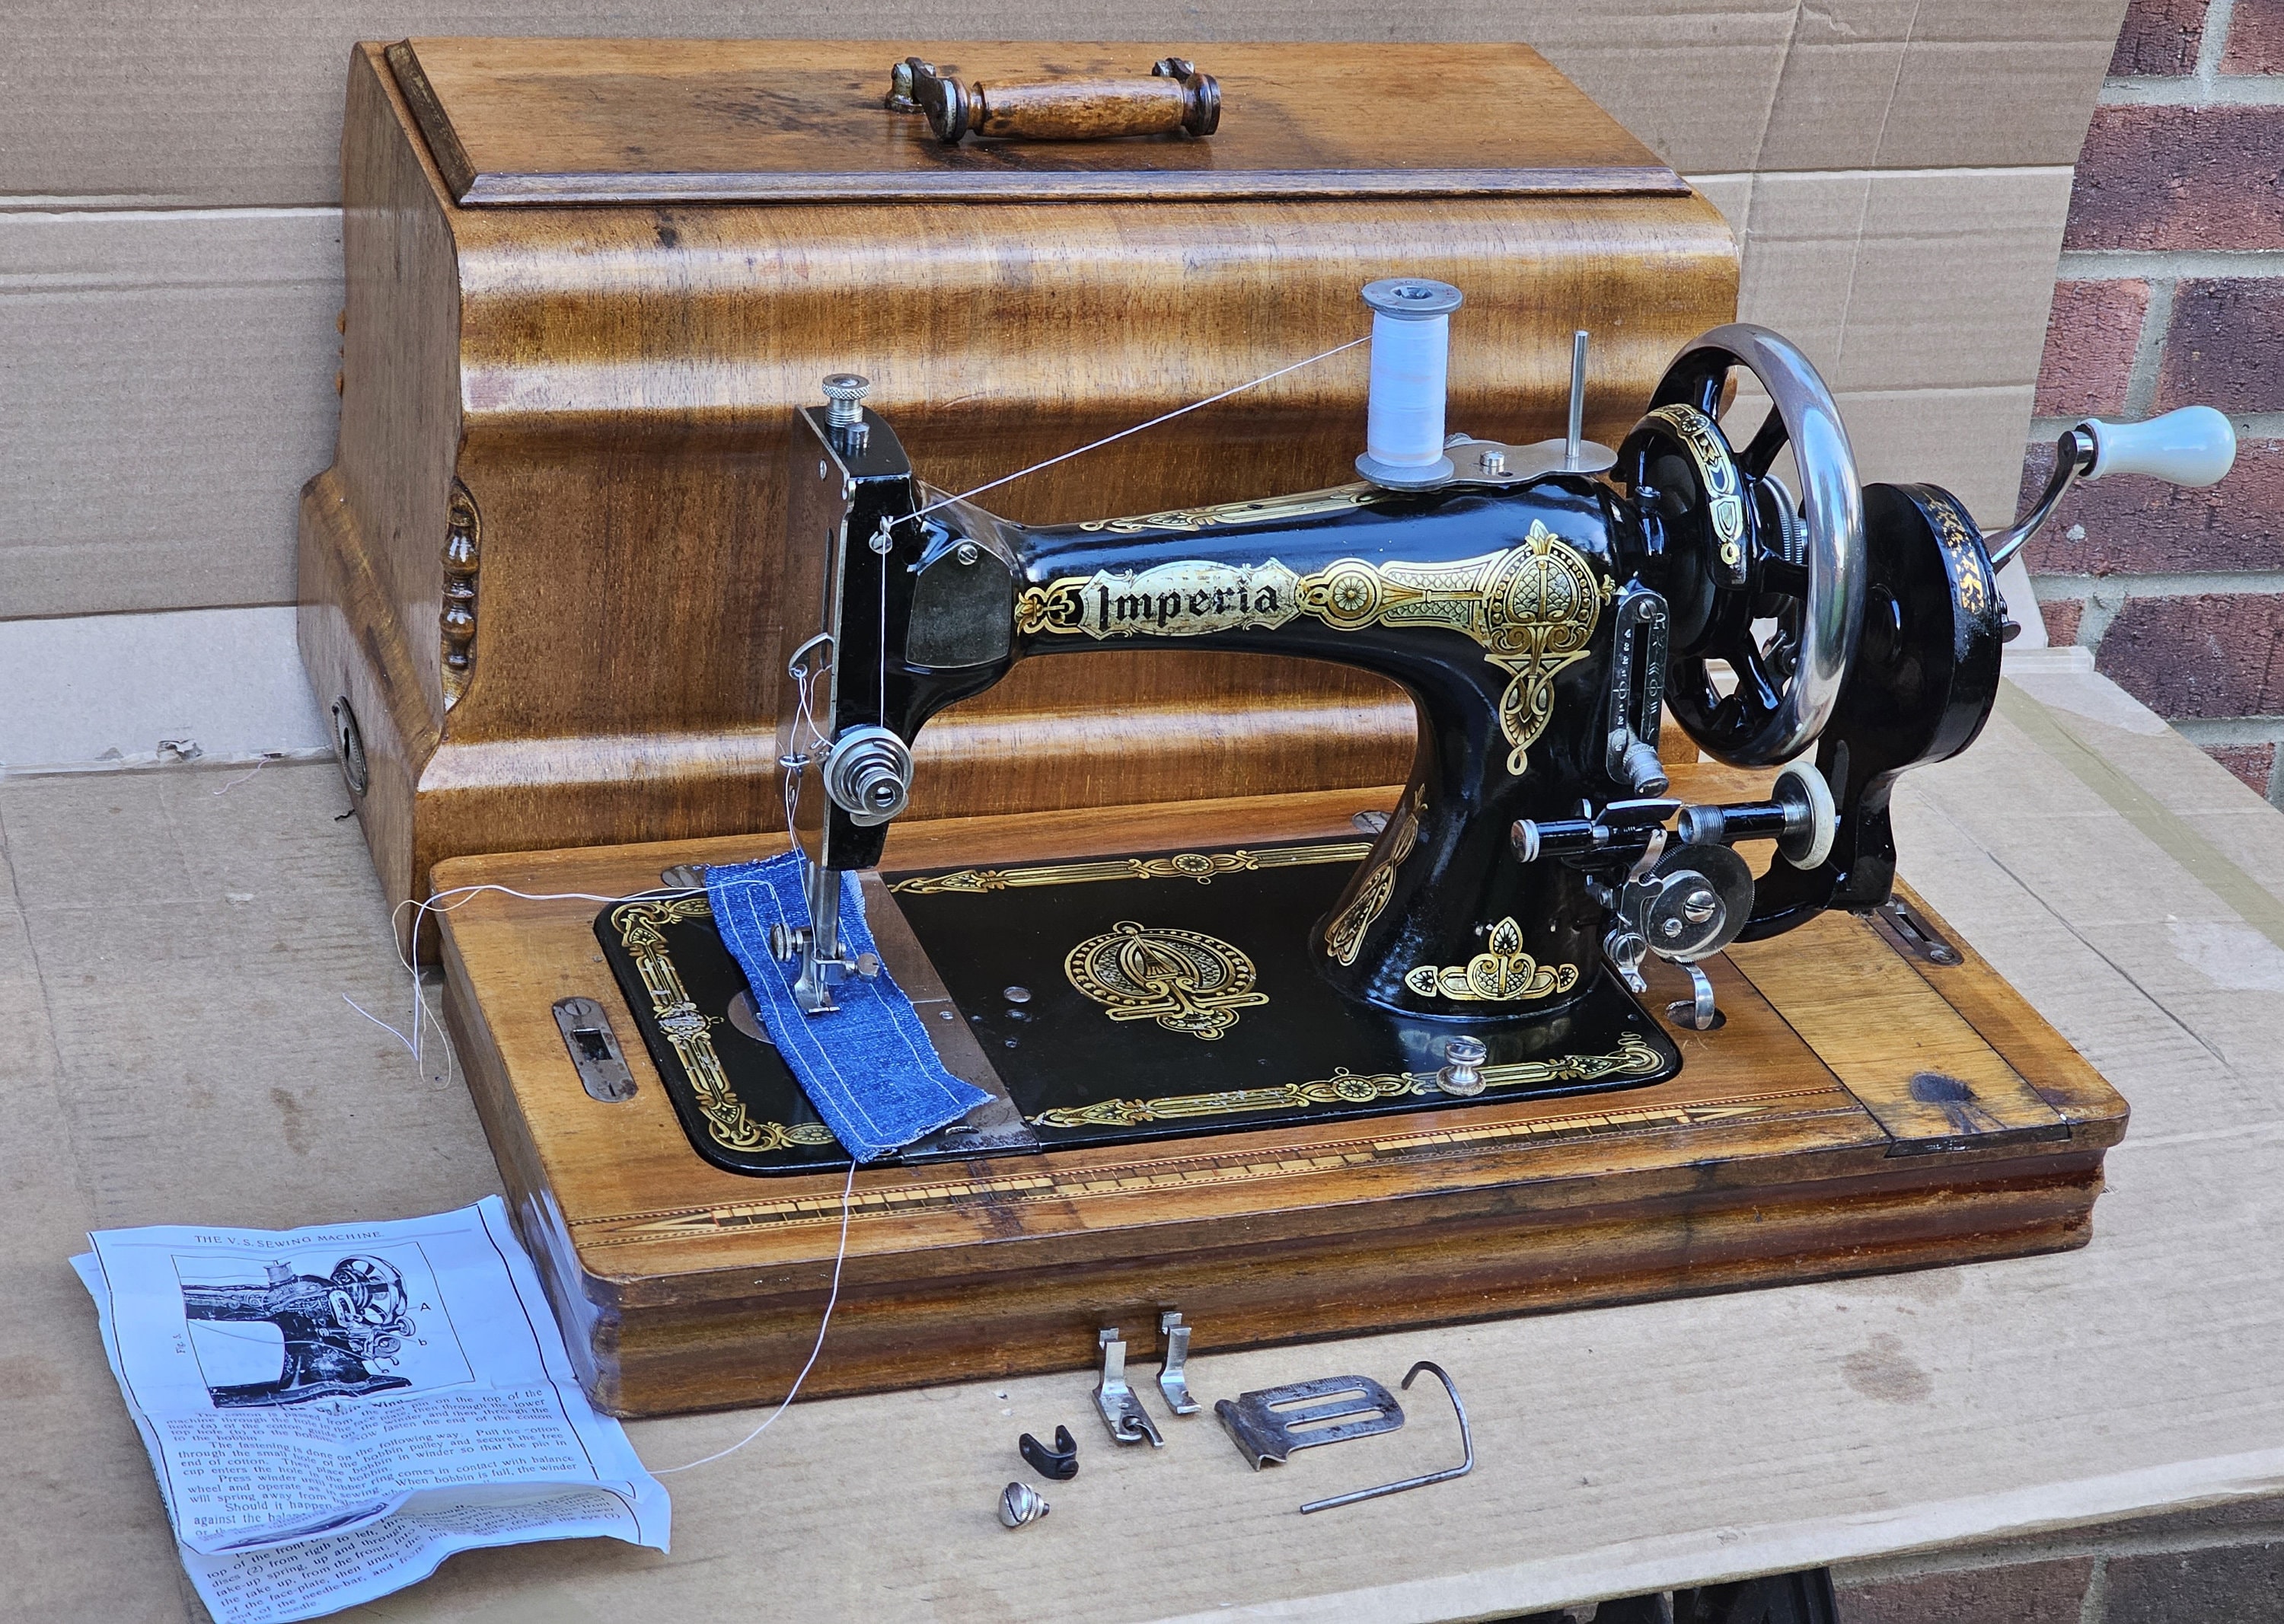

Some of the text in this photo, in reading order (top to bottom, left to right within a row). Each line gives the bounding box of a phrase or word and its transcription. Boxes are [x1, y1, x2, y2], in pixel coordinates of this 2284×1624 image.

[1097, 579, 1281, 632] Imperia
[1653, 613, 1666, 630] R
[195, 1231, 385, 1249] THE V. S. SEWING MACHINE.
[420, 1303, 431, 1311] A
